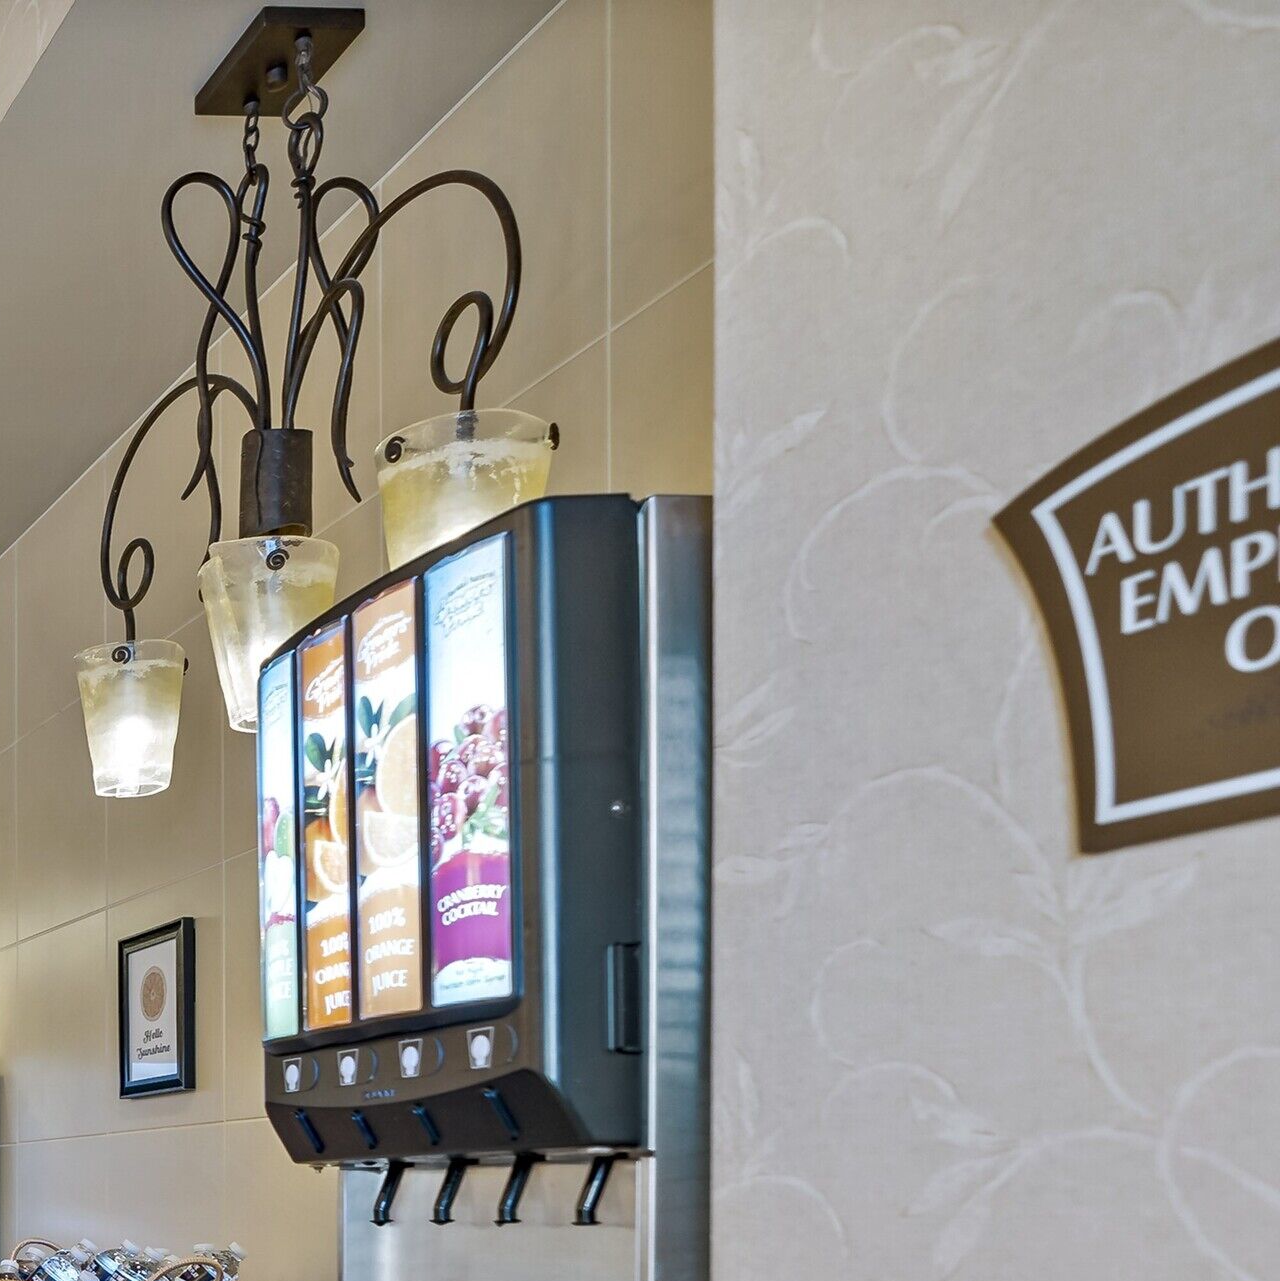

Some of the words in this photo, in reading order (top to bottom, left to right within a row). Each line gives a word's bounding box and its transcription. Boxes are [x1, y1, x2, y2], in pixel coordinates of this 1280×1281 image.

[1120, 531, 1280, 635] EMP
[437, 884, 507, 912] CRANBERRY
[368, 906, 406, 935] 100%
[441, 901, 499, 926] COCKTAIL
[365, 938, 415, 964] ORANGE
[371, 968, 409, 996] JUICE
[143, 1028, 163, 1044] Hello
[136, 1043, 171, 1060] Sunshine
